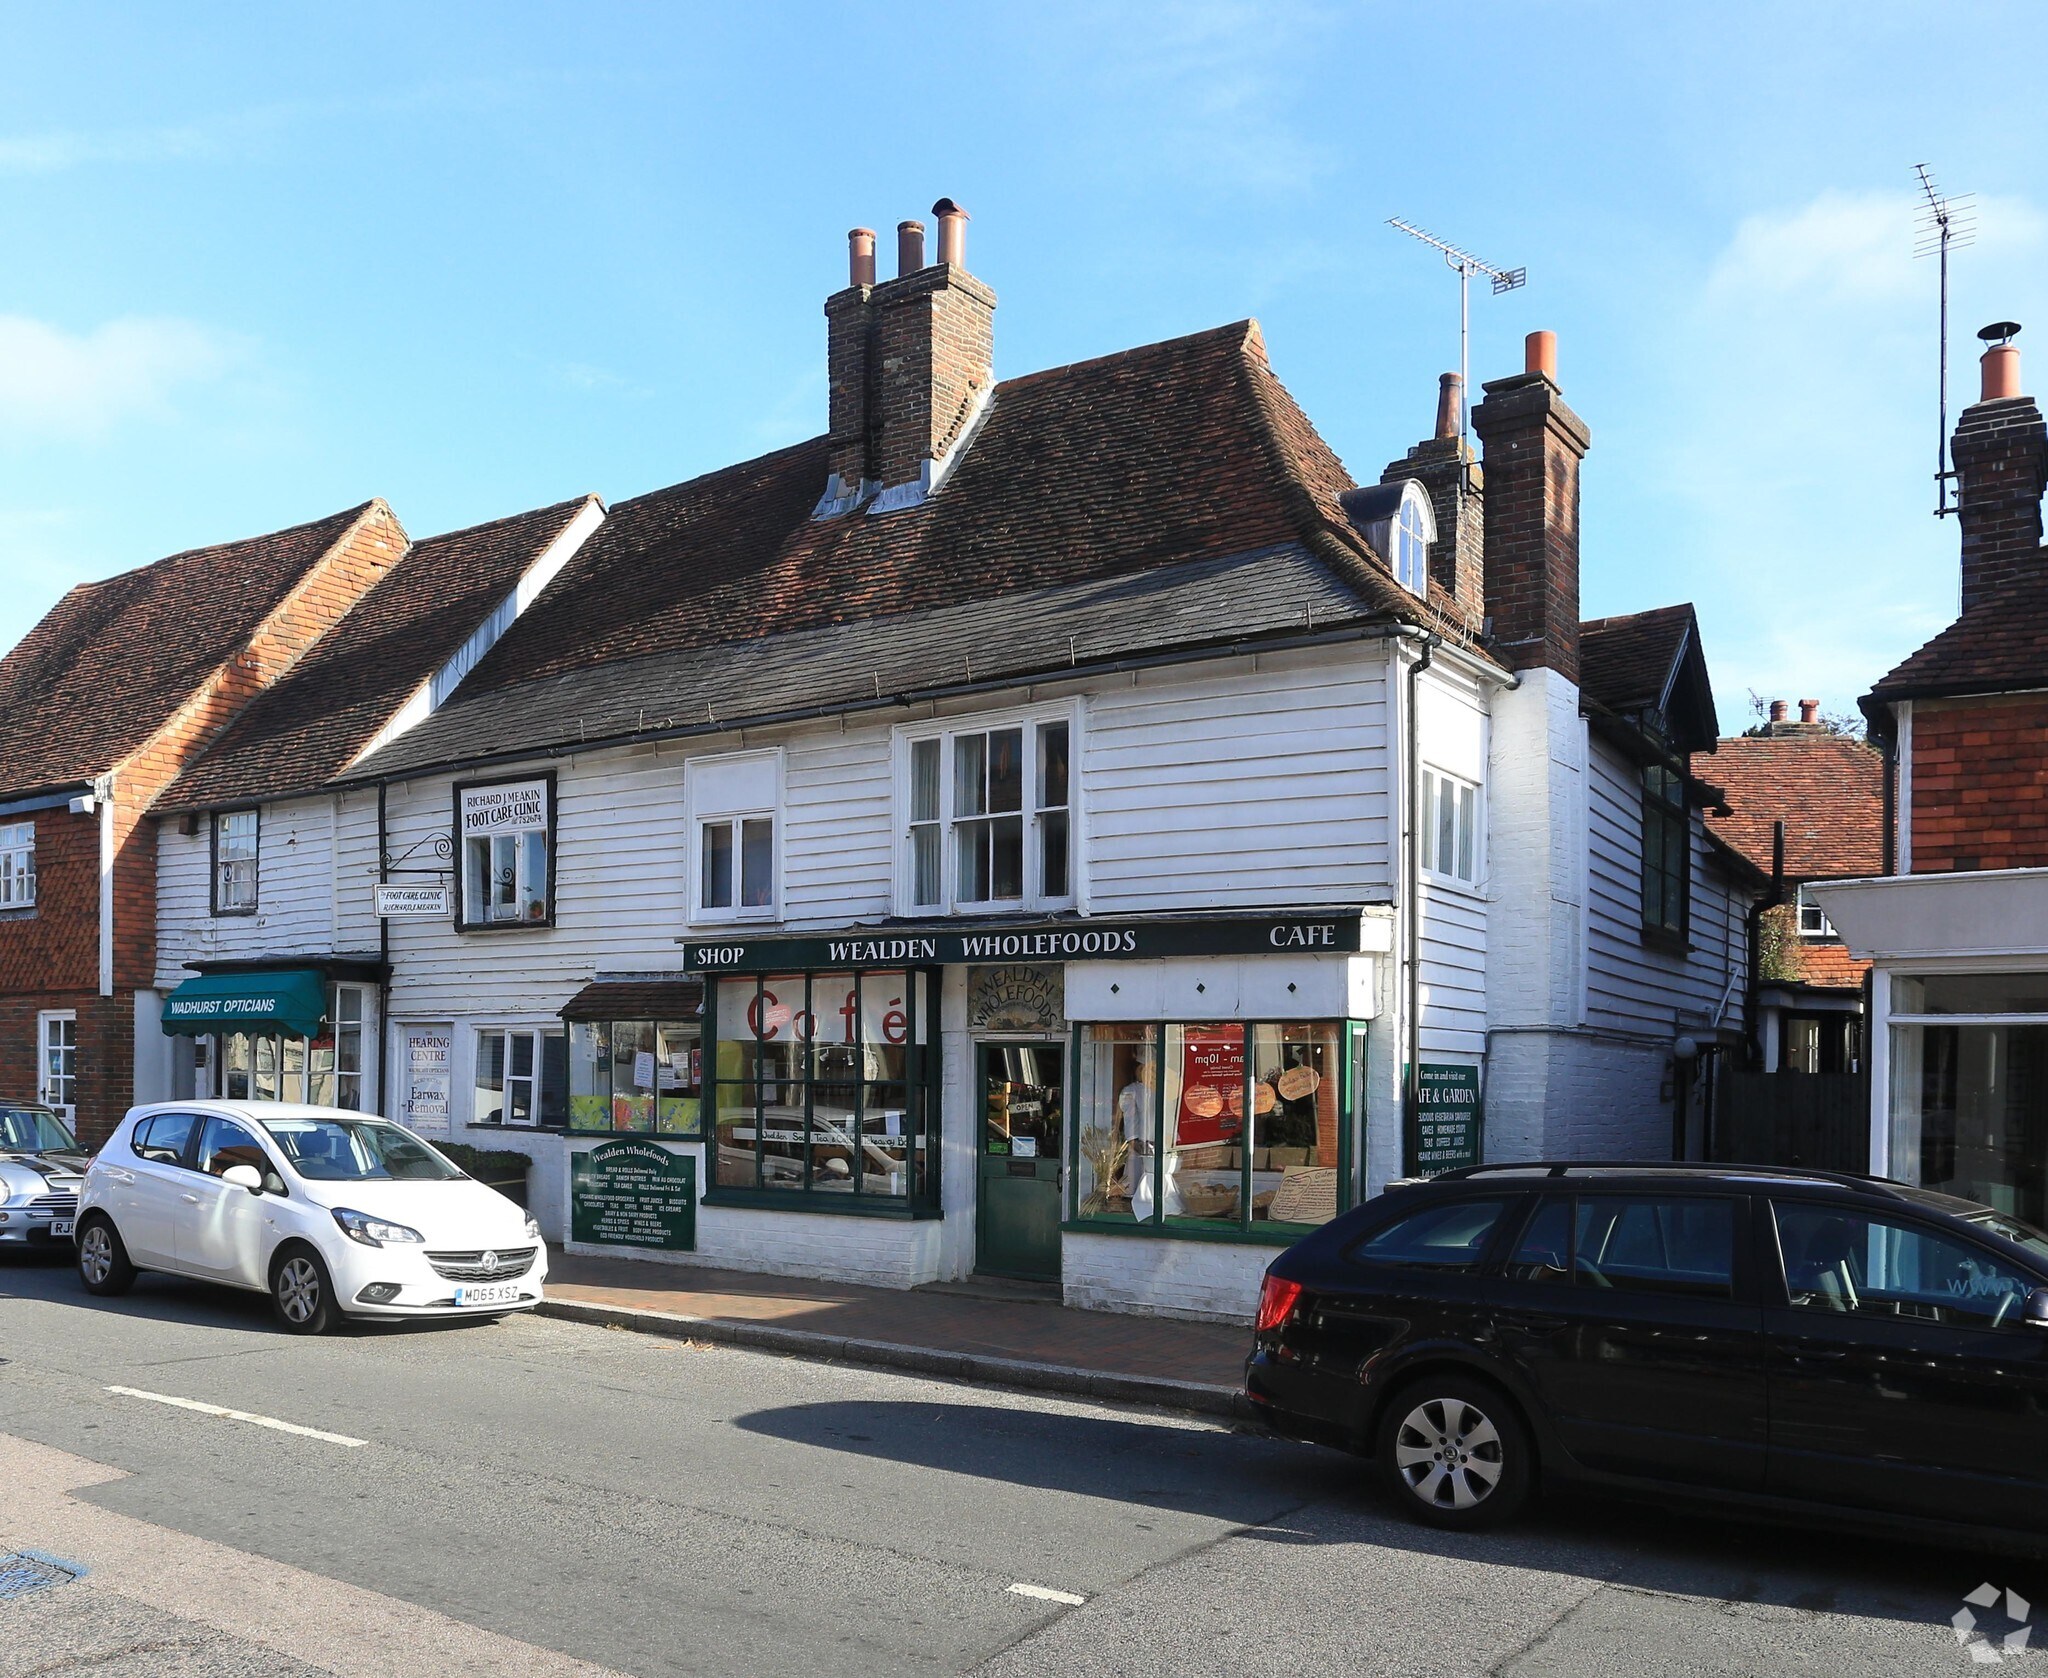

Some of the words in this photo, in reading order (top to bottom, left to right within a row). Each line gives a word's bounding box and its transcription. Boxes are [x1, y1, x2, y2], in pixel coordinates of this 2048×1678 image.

[467, 794, 502, 808] RICHARD
[508, 789, 540, 803] MEAKIN
[466, 810, 490, 828] FOOT
[491, 805, 513, 822] CARE
[514, 801, 541, 816] CLINIC
[519, 815, 542, 824] 782674
[386, 891, 403, 900] FOOT
[403, 892, 419, 900] CARE
[420, 891, 442, 900] CLINIC
[697, 948, 744, 965] SHOP
[828, 938, 936, 961] WEALDEN
[961, 930, 1136, 956] WHOLEFOODS
[1270, 925, 1335, 946] CAFE
[978, 966, 1054, 997] WEALDEN
[171, 1000, 221, 1014] WADHURST
[224, 999, 276, 1013] OPTICIANS
[973, 985, 1058, 1026] WHOLEFOODS
[746, 990, 906, 1044] Café
[409, 1037, 450, 1048] HEARING
[411, 1050, 446, 1061] CENTRE
[1420, 1071, 1434, 1080] Come
[1434, 1071, 1439, 1080] in
[1440, 1071, 1448, 1080] and
[1449, 1071, 1458, 1080] visit
[411, 1087, 445, 1100] Earwax
[1418, 1088, 1431, 1103] FE
[1433, 1088, 1440, 1103] &
[1443, 1088, 1475, 1103] GARDEN
[407, 1100, 448, 1113] Removal
[593, 1148, 625, 1163] Wealden
[626, 1146, 669, 1166] Wholefoods
[465, 1288, 495, 1301] MD65
[498, 1286, 517, 1299] XSZ
